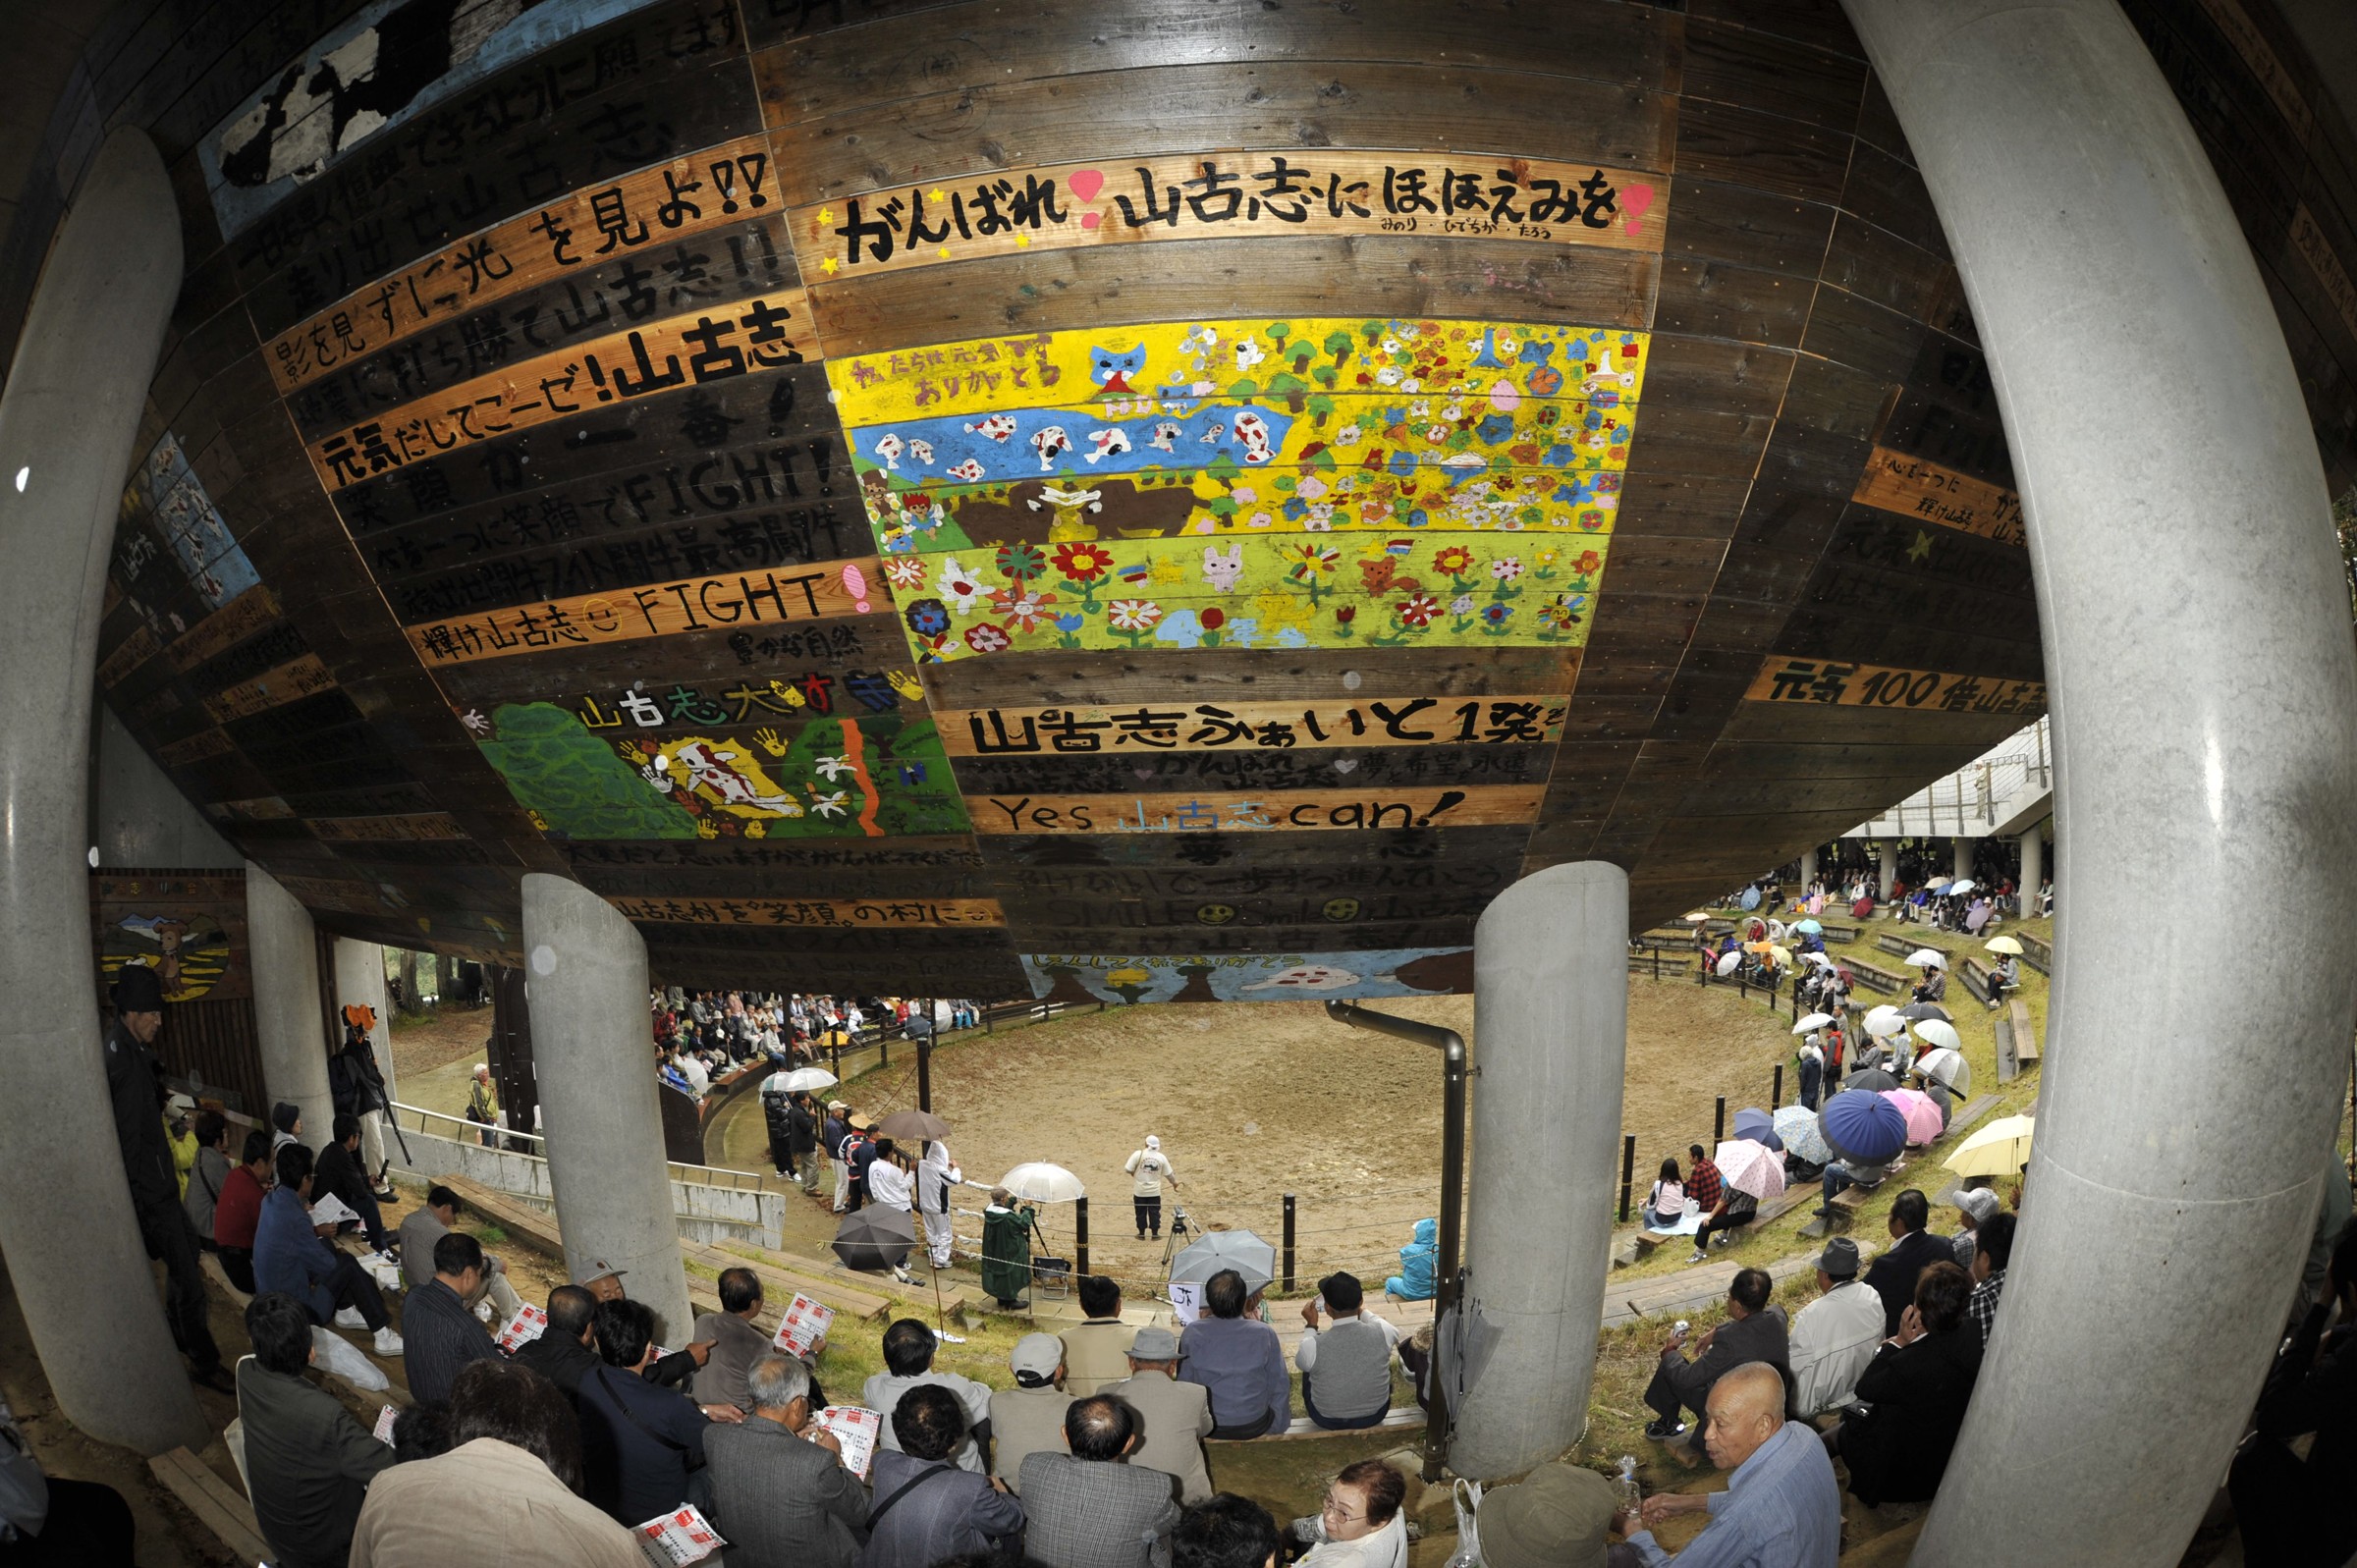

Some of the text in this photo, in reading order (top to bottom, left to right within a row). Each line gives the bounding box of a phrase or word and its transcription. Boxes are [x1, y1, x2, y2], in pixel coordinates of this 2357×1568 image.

[421, 604, 590, 661] 輝け山古志
[989, 797, 1093, 832] Yes
[1288, 790, 1467, 830] can!
